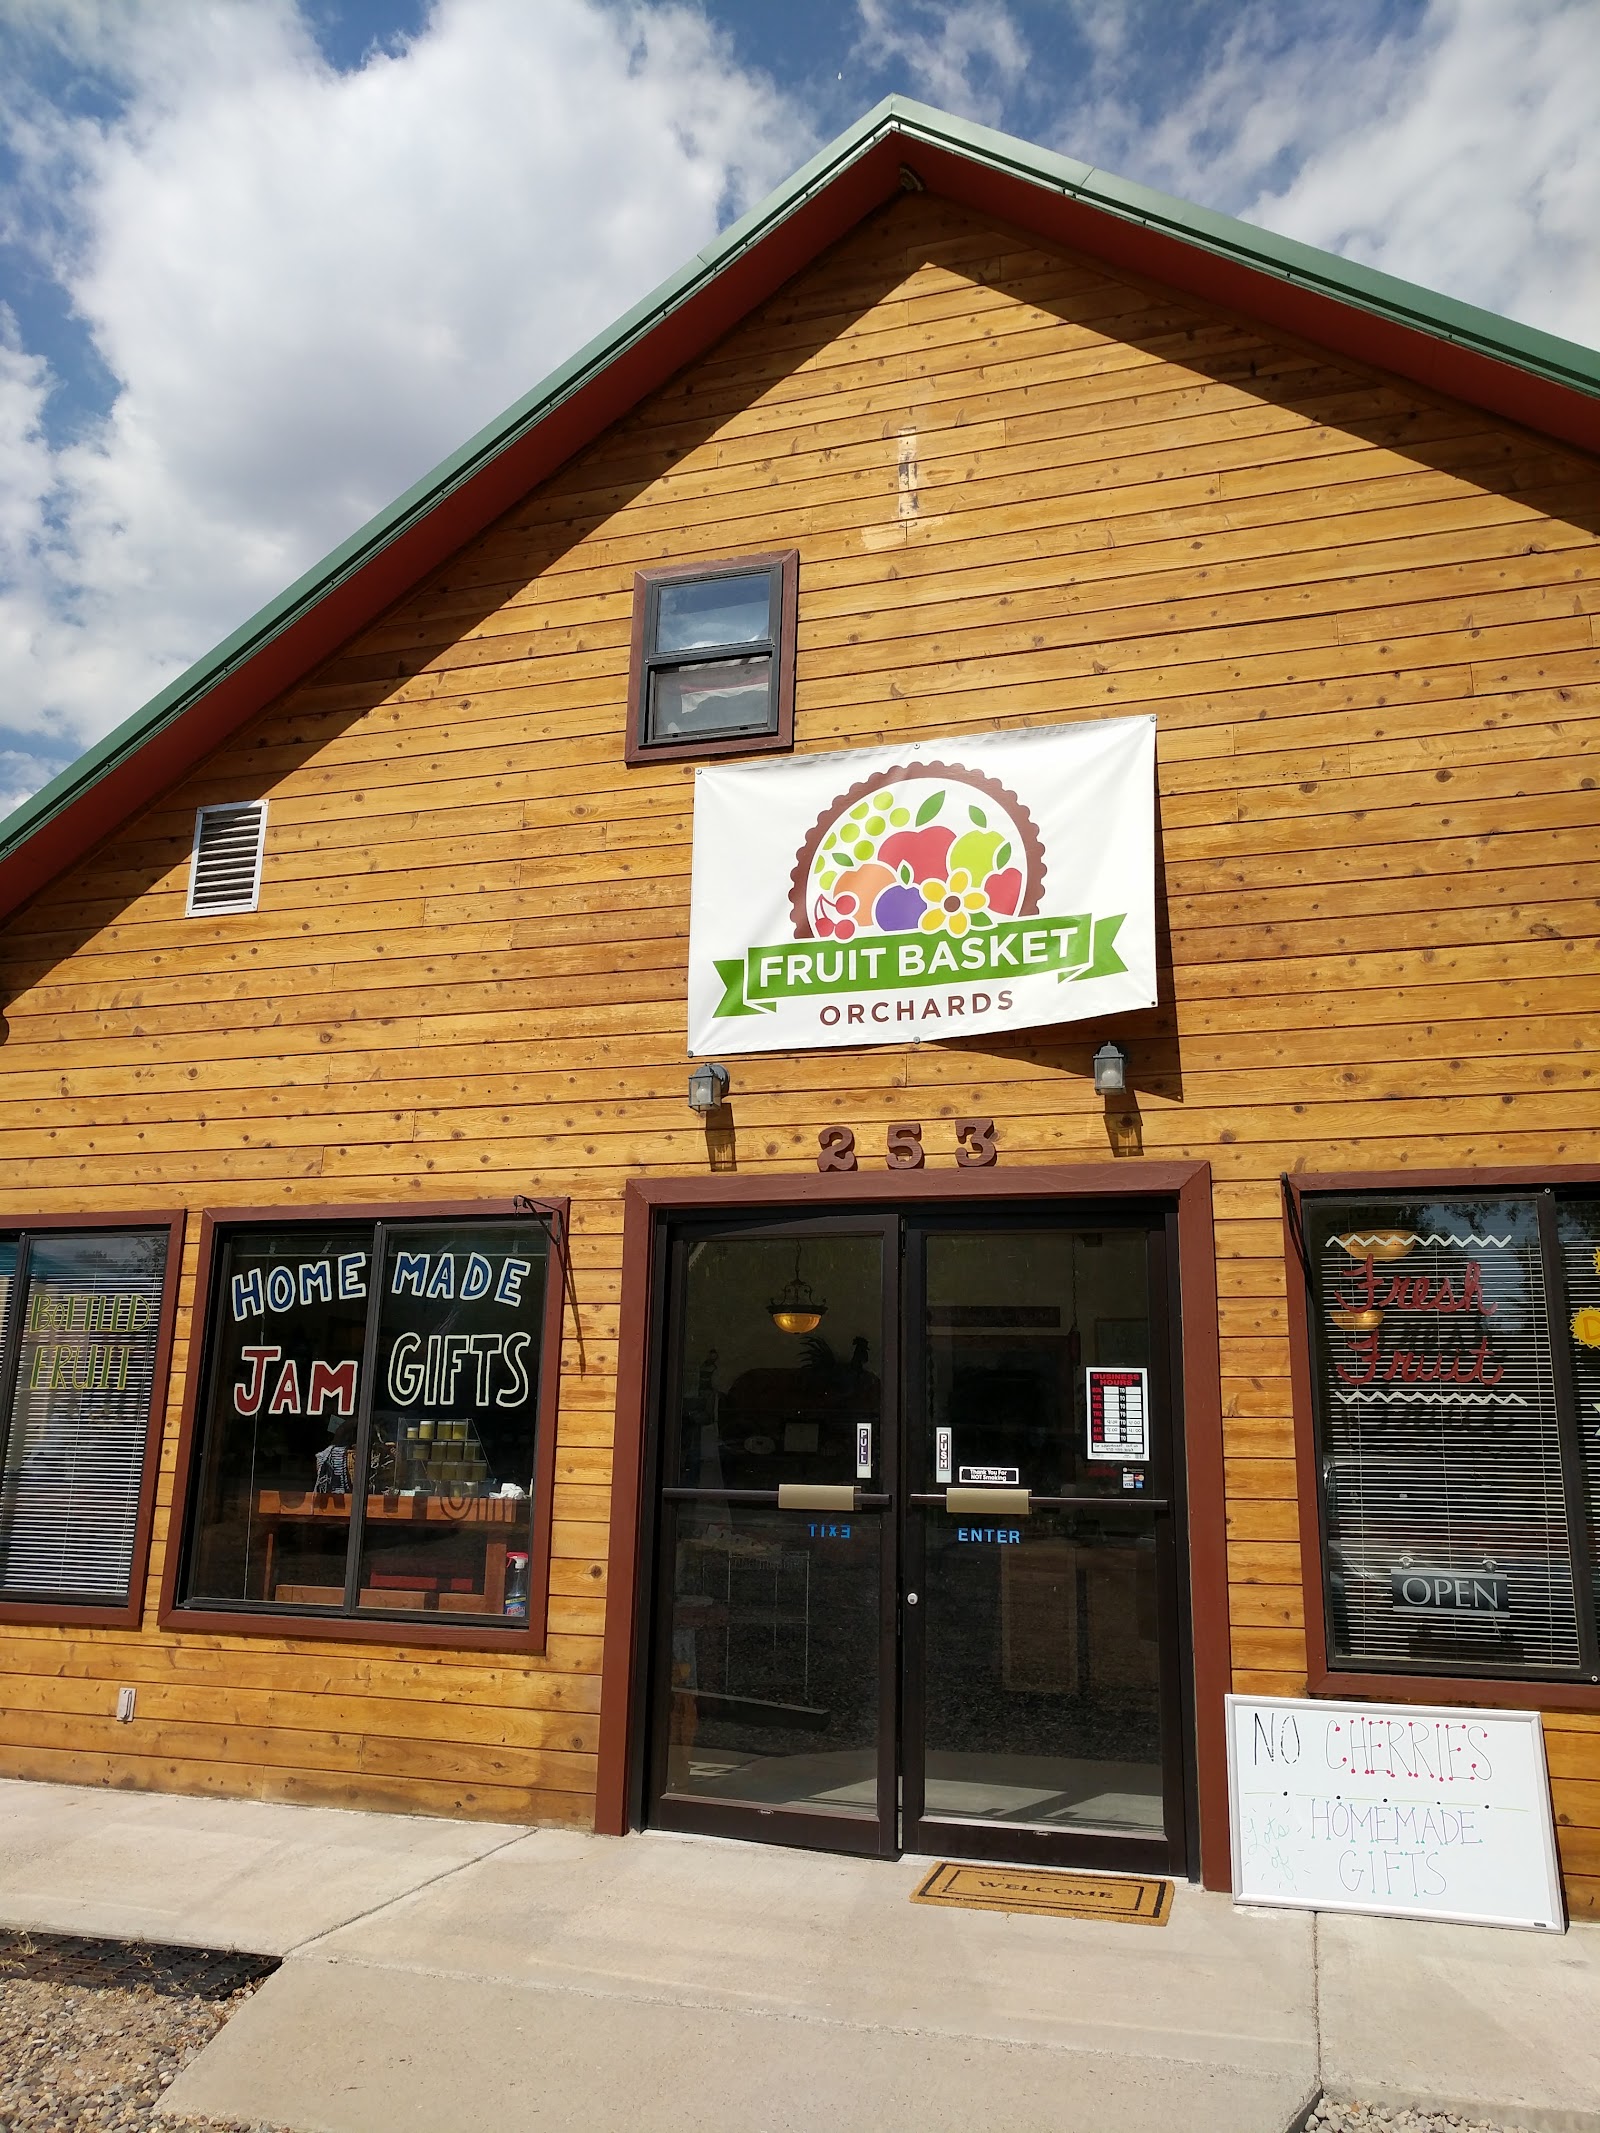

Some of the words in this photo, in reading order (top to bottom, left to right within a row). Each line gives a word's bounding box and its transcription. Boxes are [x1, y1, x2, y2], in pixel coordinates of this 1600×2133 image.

[759, 946, 888, 989] FRUIT
[897, 927, 1079, 978] BASKET
[819, 990, 1015, 1027] ORCHARDS
[231, 1251, 367, 1321] HOME
[391, 1251, 532, 1307] MADE
[1333, 1252, 1498, 1316] Fresh
[29, 1344, 135, 1391] FRUIT
[233, 1345, 359, 1416] JAM
[387, 1331, 532, 1408] GIFTS
[1336, 1327, 1504, 1386] Fruit
[940, 1434, 948, 1468] PUSH
[983, 1474, 1006, 1482] Smoking
[957, 1528, 1020, 1544] ENTER
[1401, 1576, 1499, 1610] OPEN
[1254, 1712, 1301, 1766] NO
[1325, 1717, 1493, 1782] CHERRIES
[1311, 1798, 1484, 1846] HOMEMADE
[978, 1881, 1114, 1899] WELCOME
[1338, 1849, 1447, 1898] GIFTS
